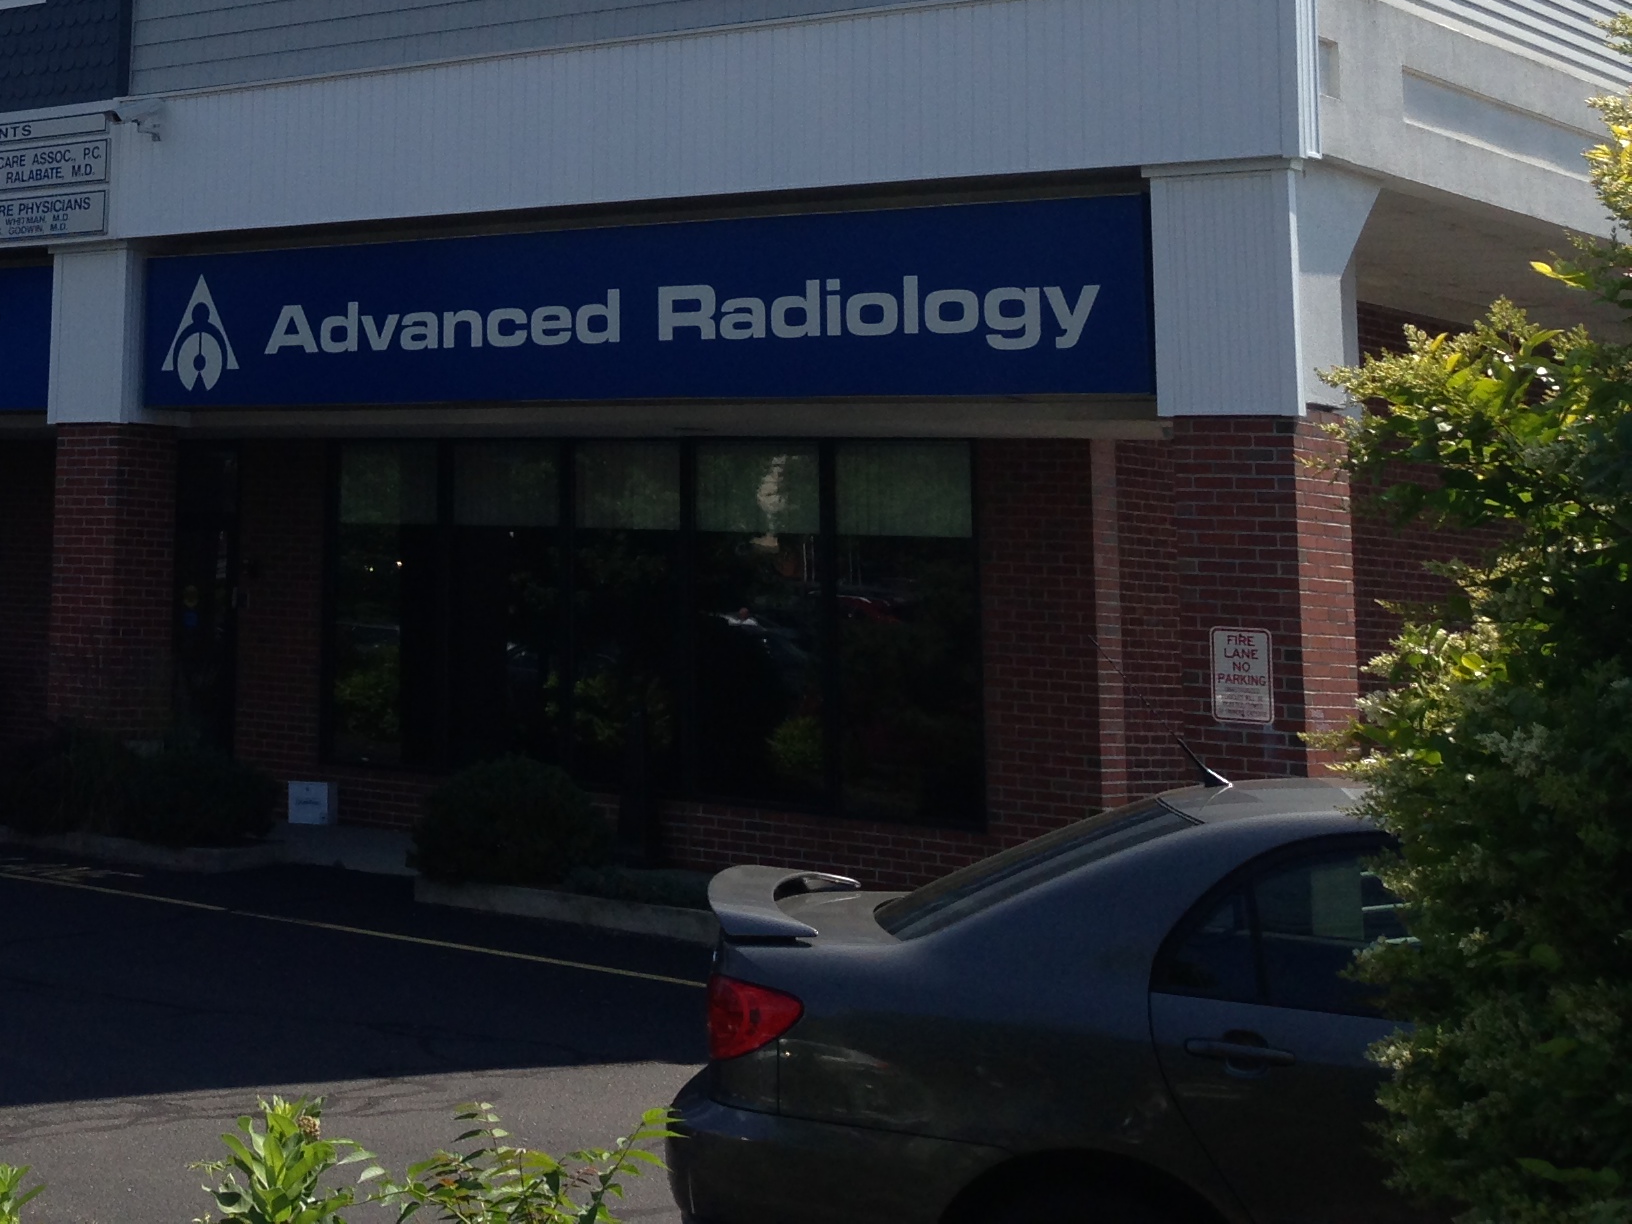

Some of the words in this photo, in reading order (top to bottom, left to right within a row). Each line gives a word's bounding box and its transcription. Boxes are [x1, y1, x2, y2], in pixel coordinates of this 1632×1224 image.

[18, 196, 91, 216] PHYSICIANS
[262, 287, 621, 356] Advanced
[657, 274, 1101, 351] Radiology
[1227, 635, 1255, 646] FIRE
[1224, 648, 1258, 659] LANE
[1232, 662, 1250, 672] NO
[1217, 673, 1266, 686] PARKING
